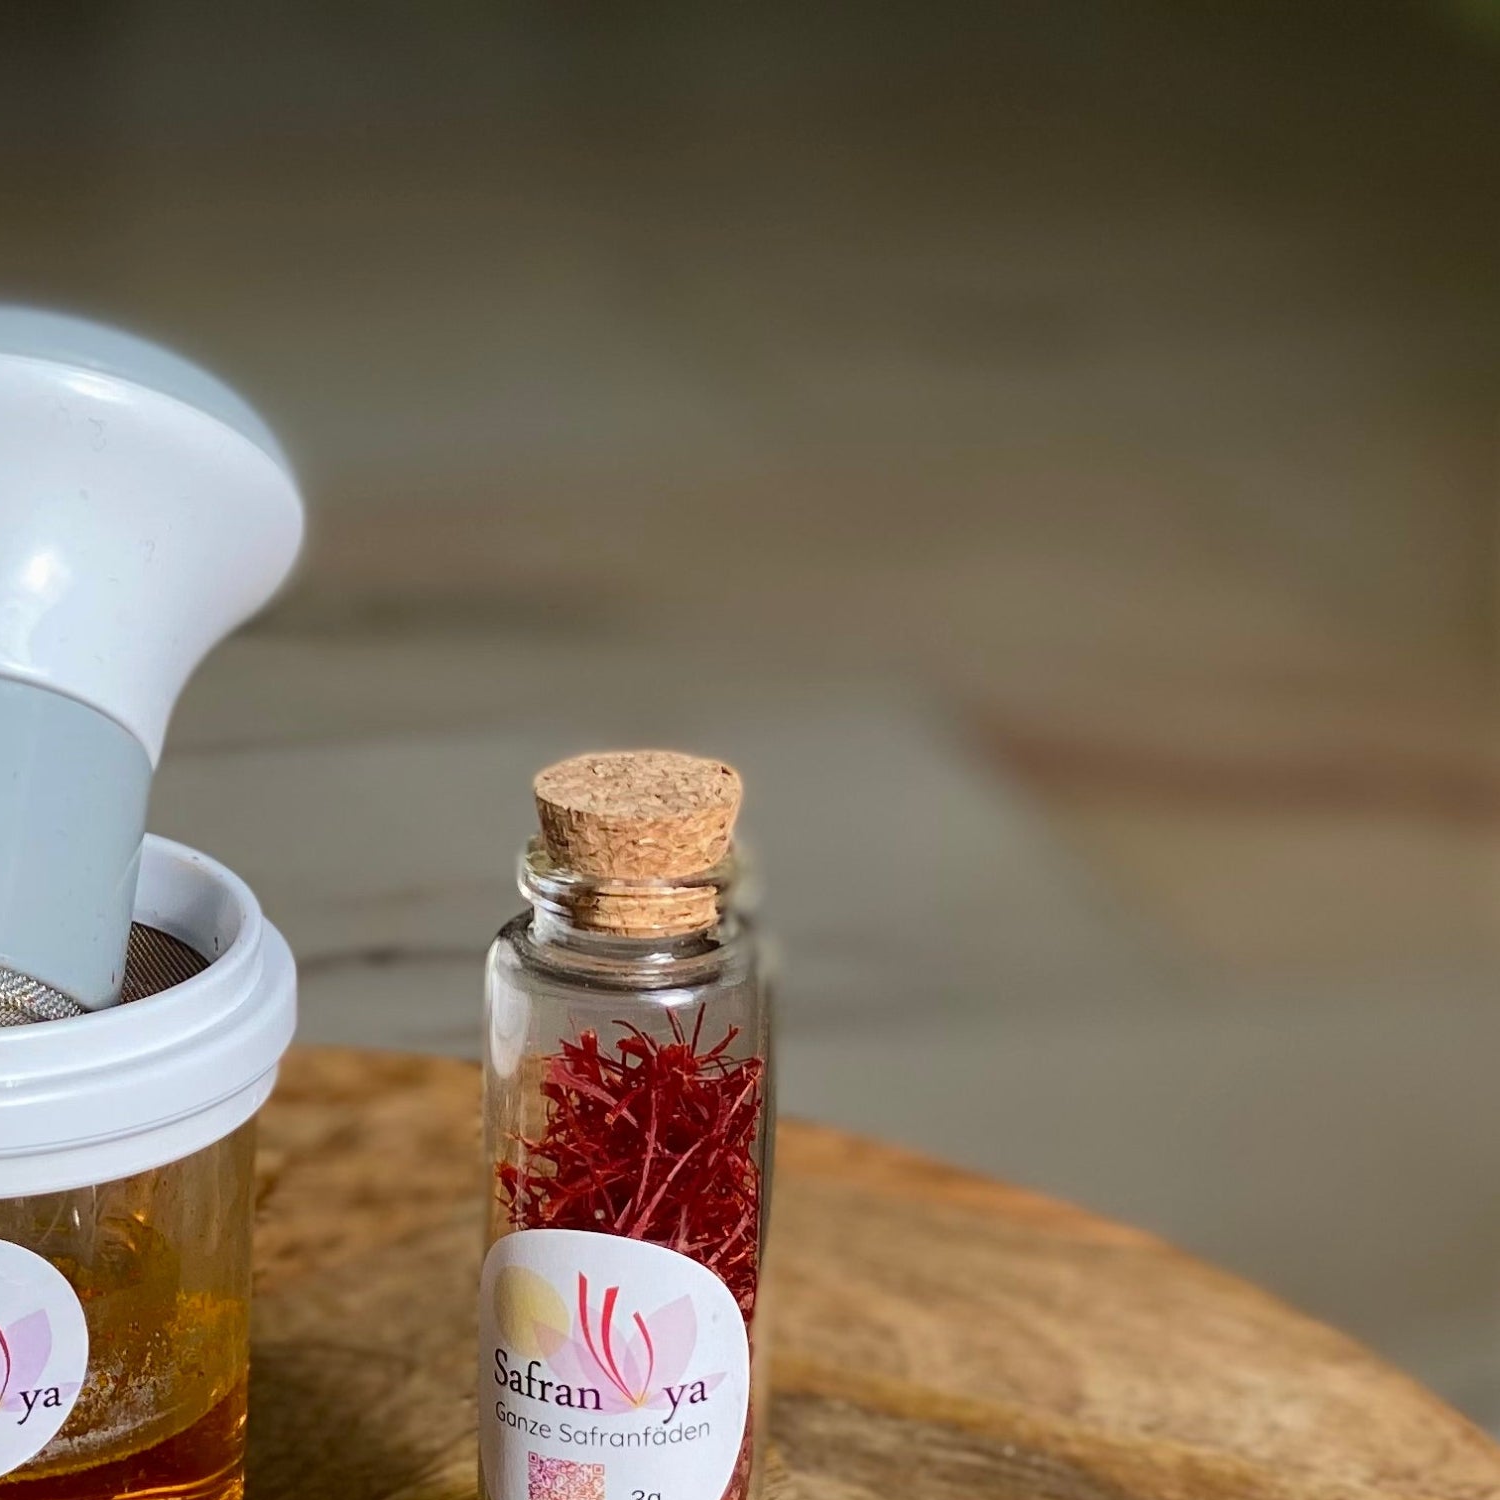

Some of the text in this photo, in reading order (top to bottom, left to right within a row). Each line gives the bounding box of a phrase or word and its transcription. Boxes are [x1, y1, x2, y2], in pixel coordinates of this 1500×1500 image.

[17, 1386, 63, 1425] ya
[494, 1348, 708, 1424] Safran ya
[495, 1401, 710, 1447] Ganze Safranfäden
